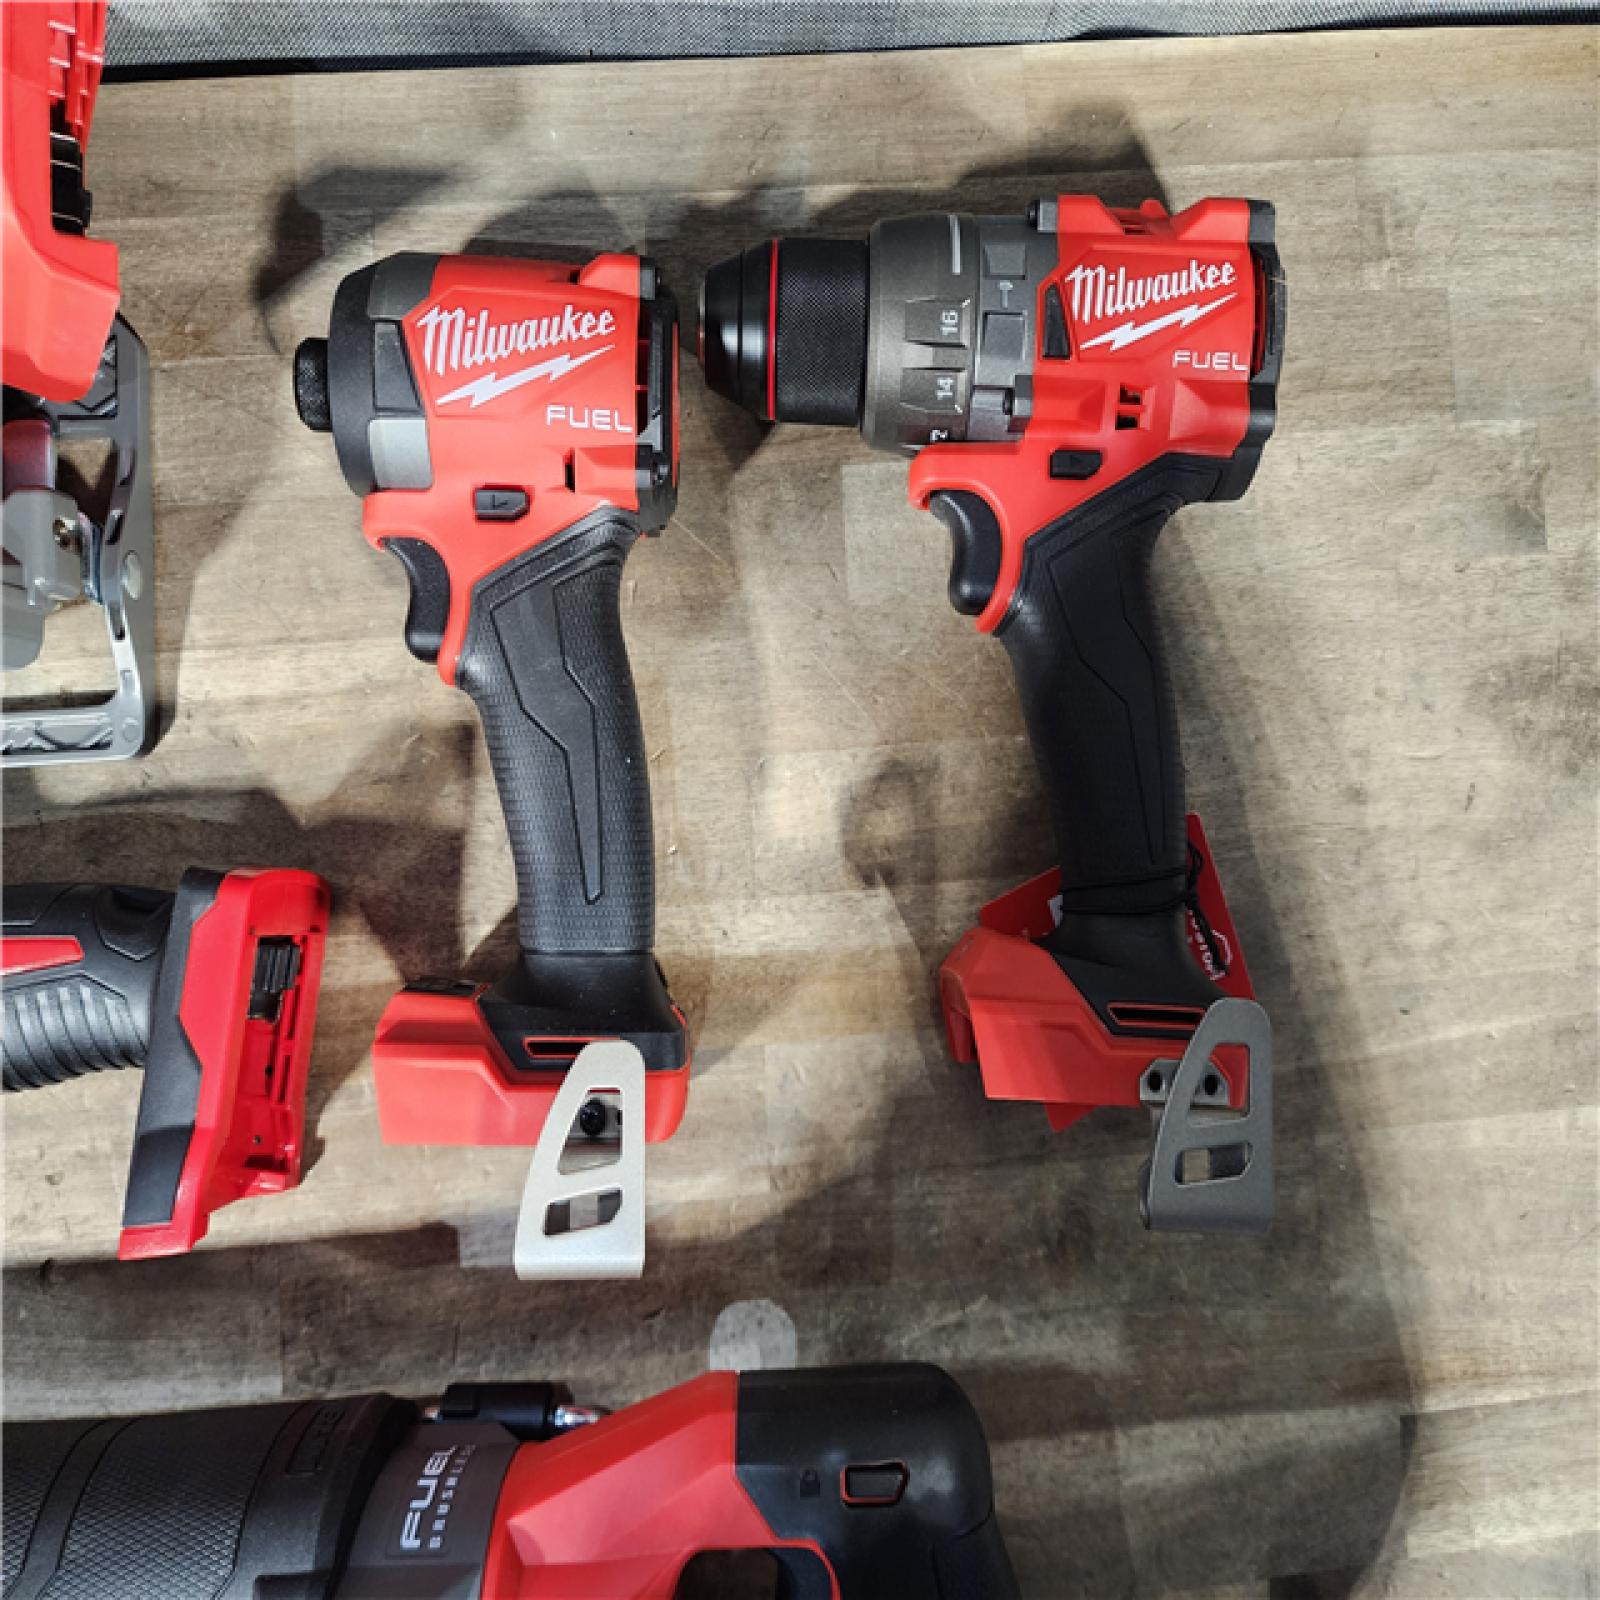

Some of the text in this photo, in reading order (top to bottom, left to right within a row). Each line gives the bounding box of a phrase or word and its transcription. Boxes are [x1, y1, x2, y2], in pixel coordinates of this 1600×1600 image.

[1065, 259, 1236, 325] Milwaukee
[416, 304, 616, 376] Milwaukee
[1172, 350, 1249, 371] FUEL
[937, 376, 954, 400] 14
[545, 404, 633, 432] FUEL
[400, 1445, 457, 1548] FUEL
